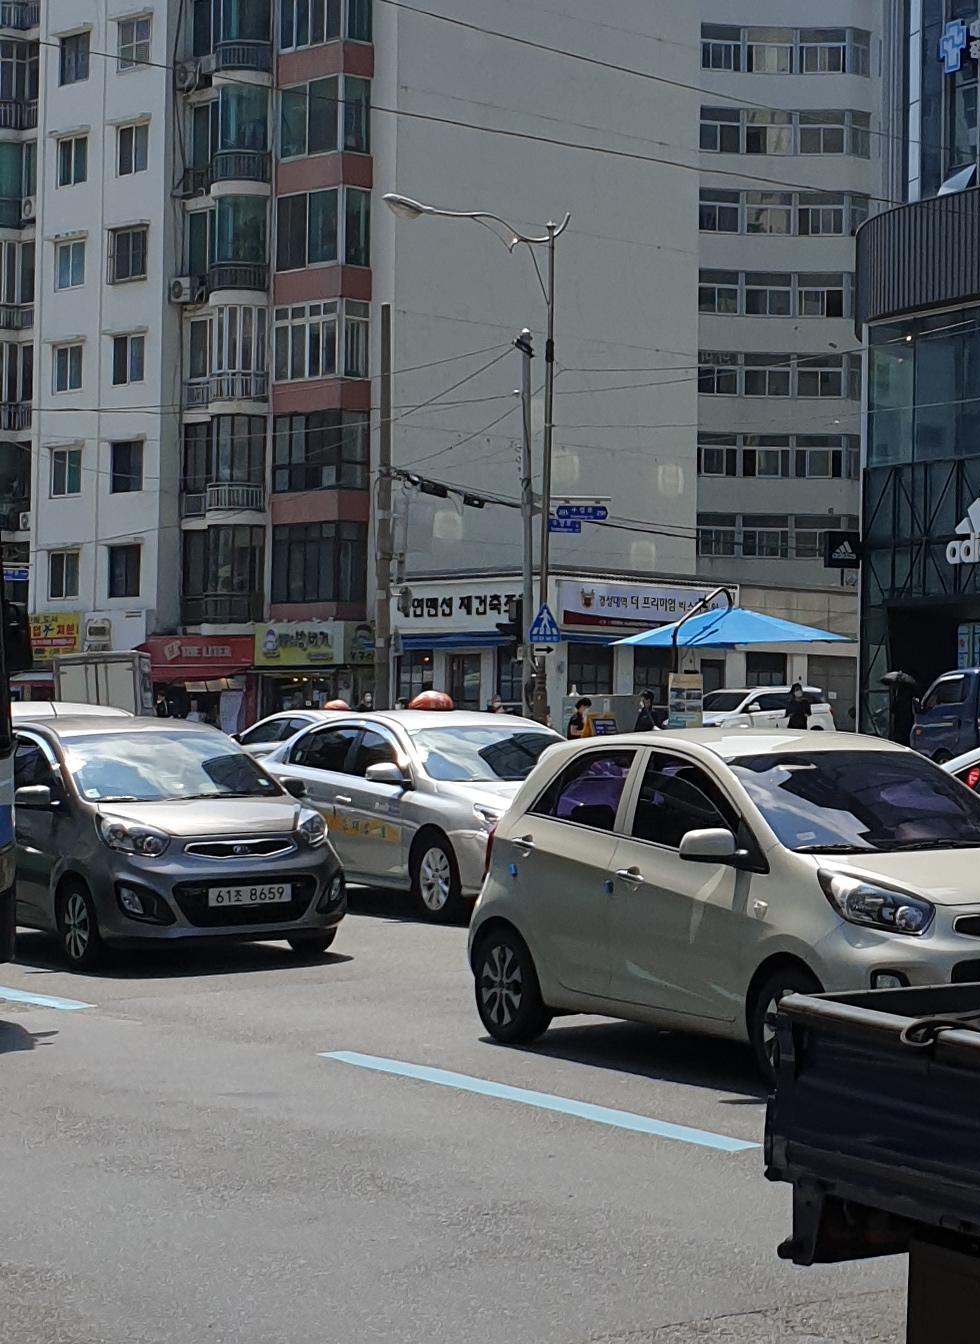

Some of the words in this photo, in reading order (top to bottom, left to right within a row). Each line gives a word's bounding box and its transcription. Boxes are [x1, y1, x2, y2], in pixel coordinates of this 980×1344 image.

[398, 596, 453, 618] 연맨션
[630, 595, 639, 610] 더
[642, 596, 676, 612] 프리미엄
[216, 889, 242, 904] 61조
[249, 886, 285, 901] 8659
